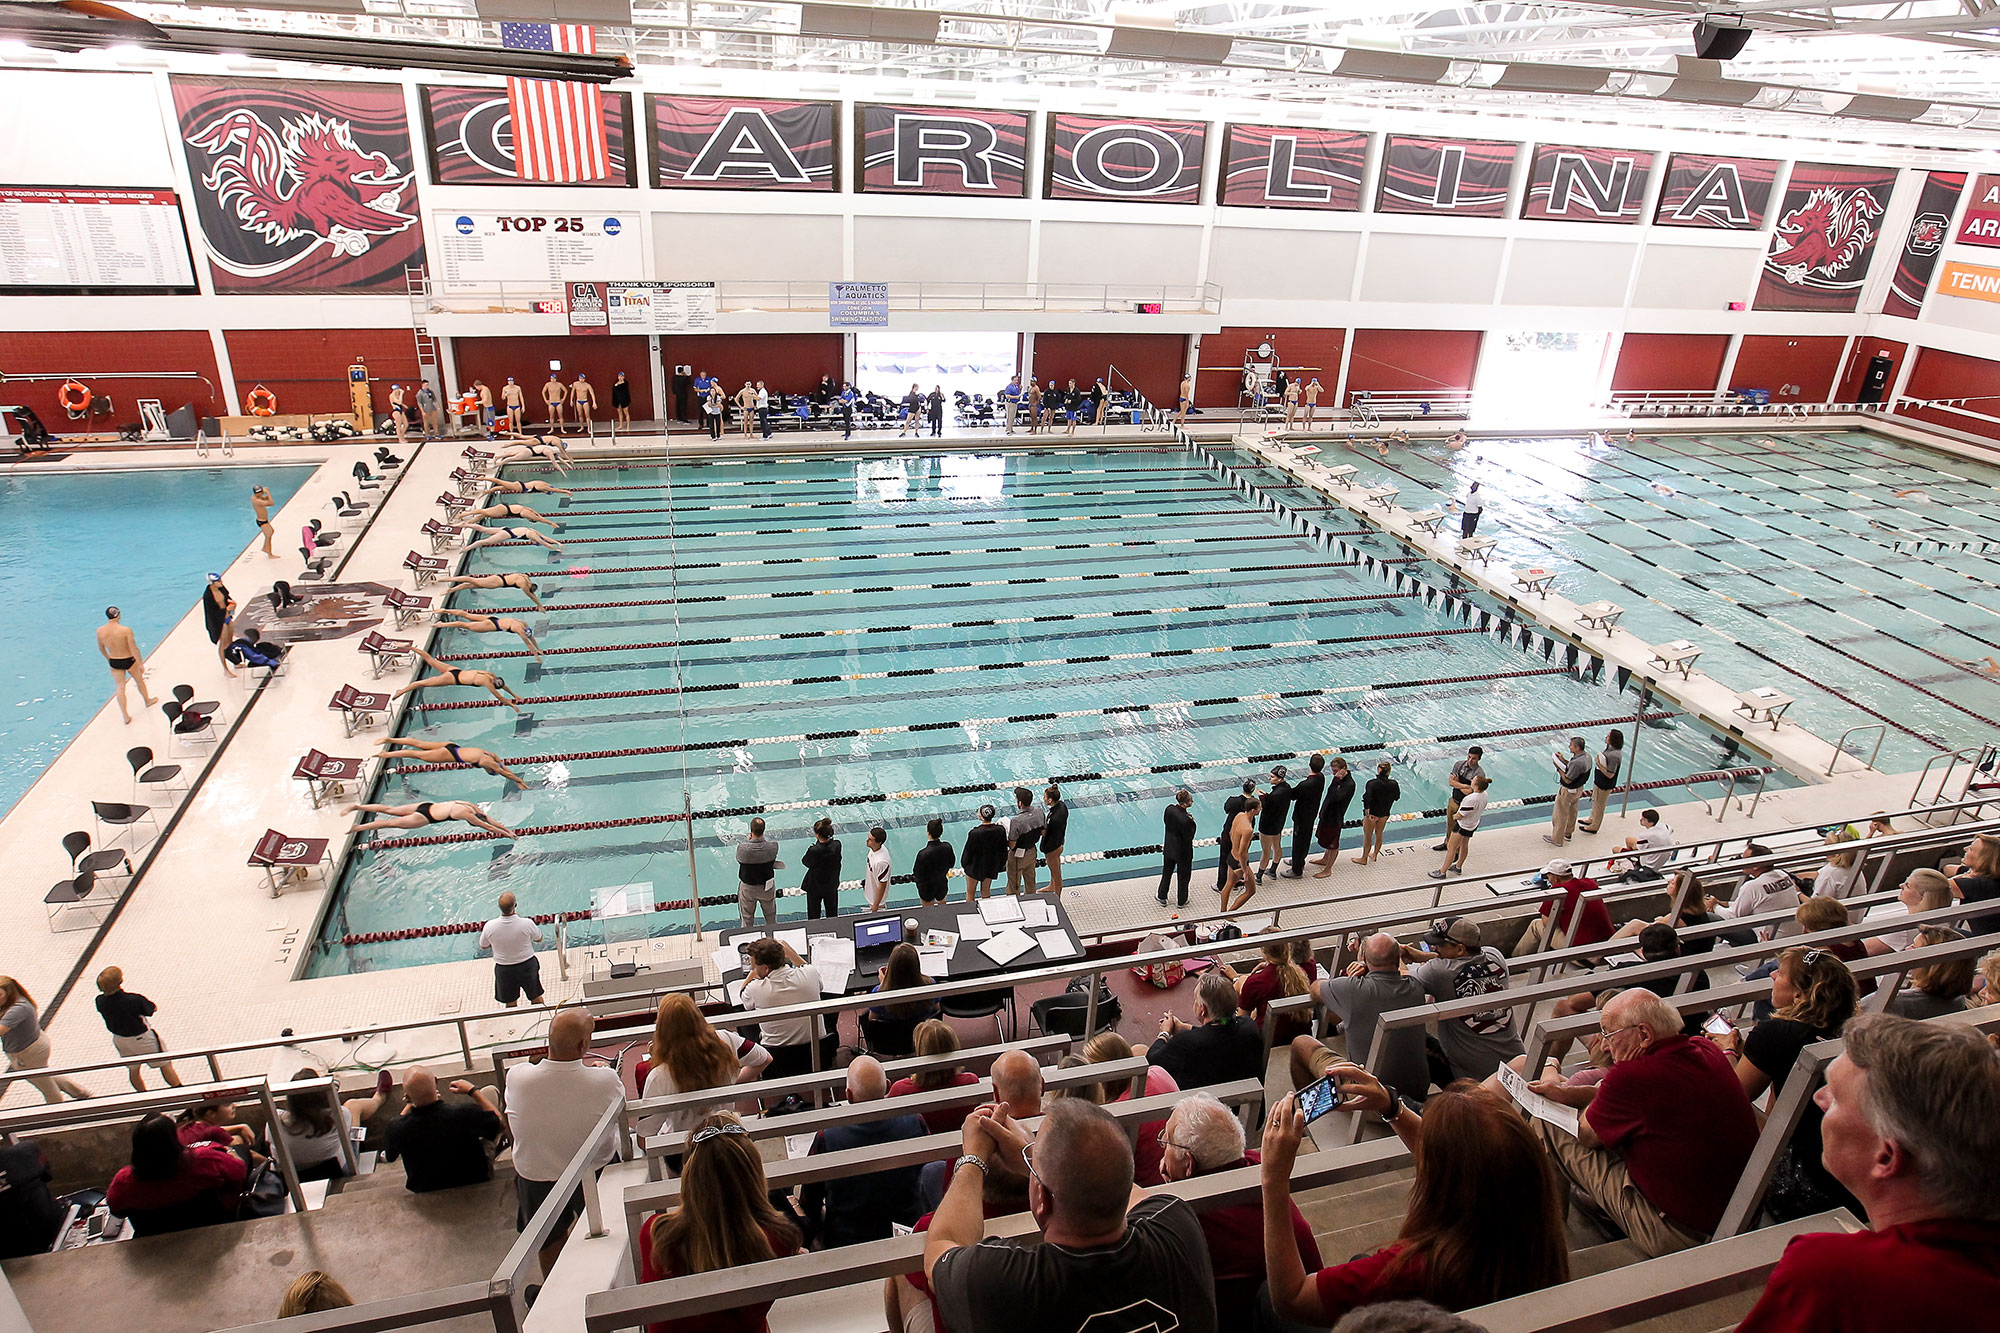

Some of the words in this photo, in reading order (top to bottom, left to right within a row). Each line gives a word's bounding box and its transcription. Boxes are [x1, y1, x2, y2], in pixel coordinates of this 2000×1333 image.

[1982, 185, 2000, 204] A
[496, 216, 547, 232] TOP
[554, 217, 584, 232] 25
[1964, 218, 2000, 238] AR
[1951, 271, 2000, 294] TENN
[539, 301, 562, 313] 4:08
[1143, 303, 1161, 313] 4:08
[617, 945, 642, 956] FT
